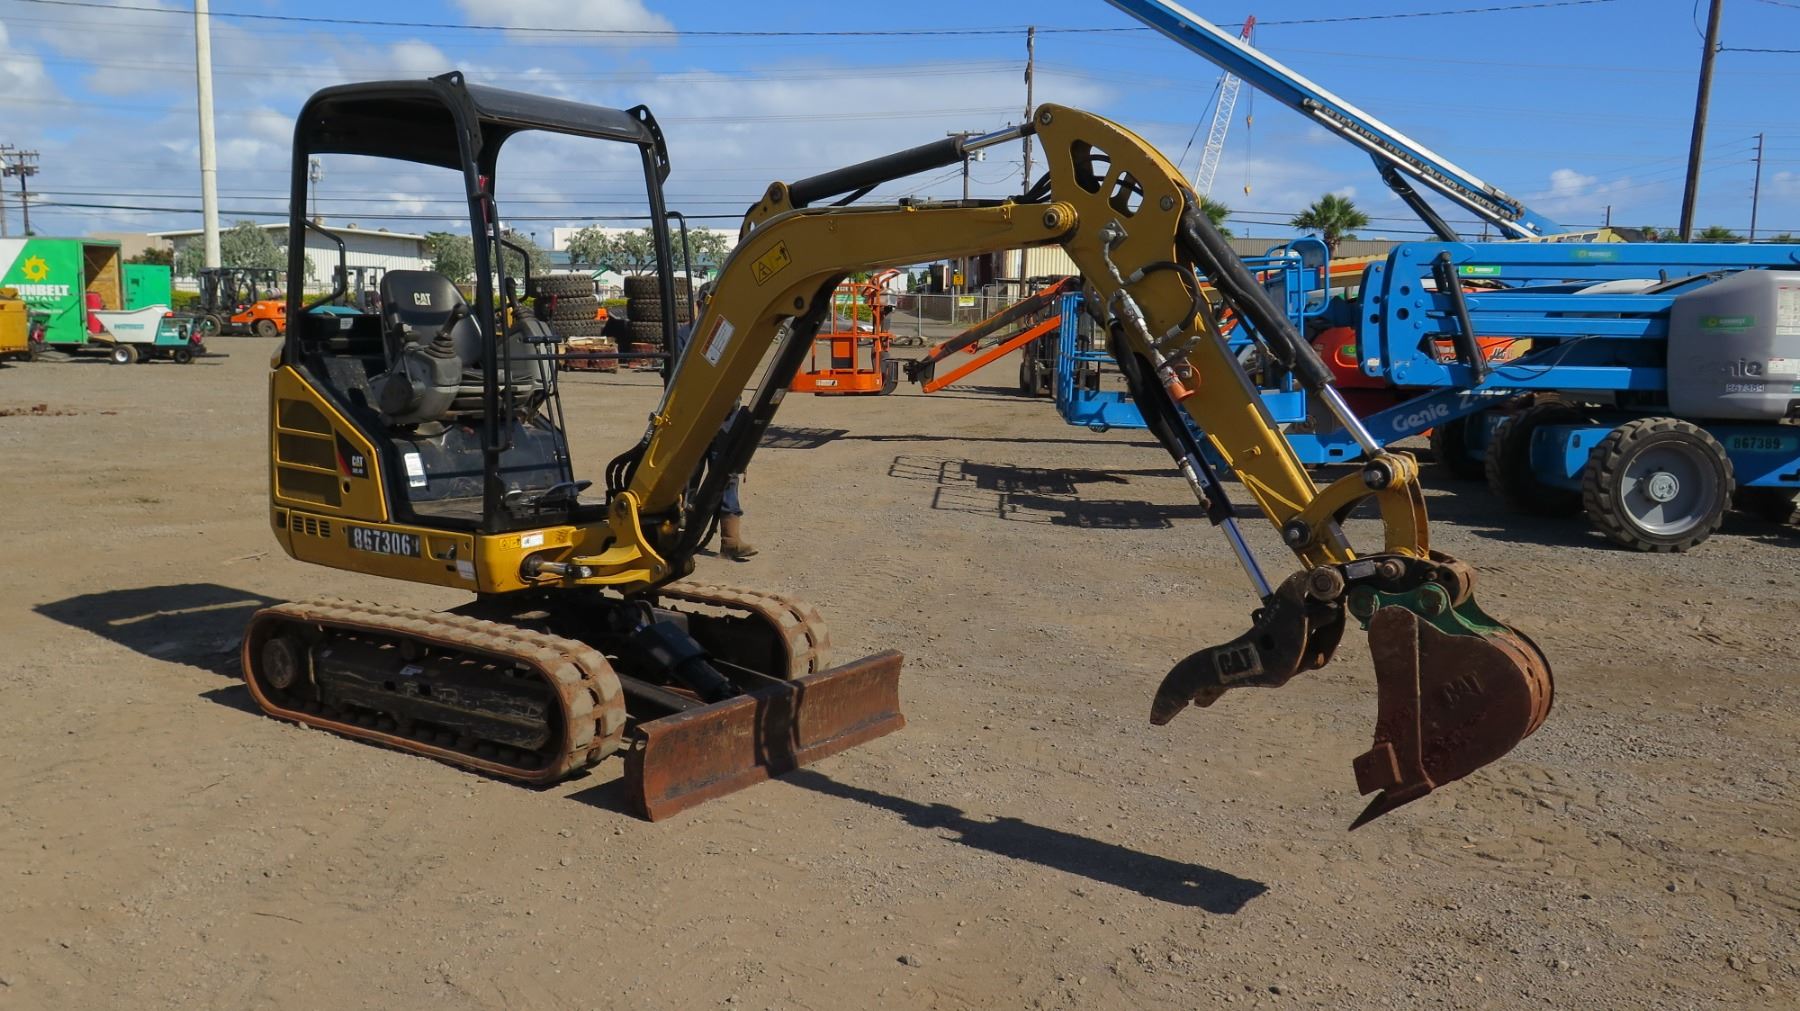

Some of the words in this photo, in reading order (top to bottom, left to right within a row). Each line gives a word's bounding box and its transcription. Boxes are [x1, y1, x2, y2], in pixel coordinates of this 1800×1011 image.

[413, 292, 432, 306] CAT
[1391, 402, 1449, 432] Genie
[1733, 437, 1781, 449] 867389
[351, 456, 364, 469] CAT
